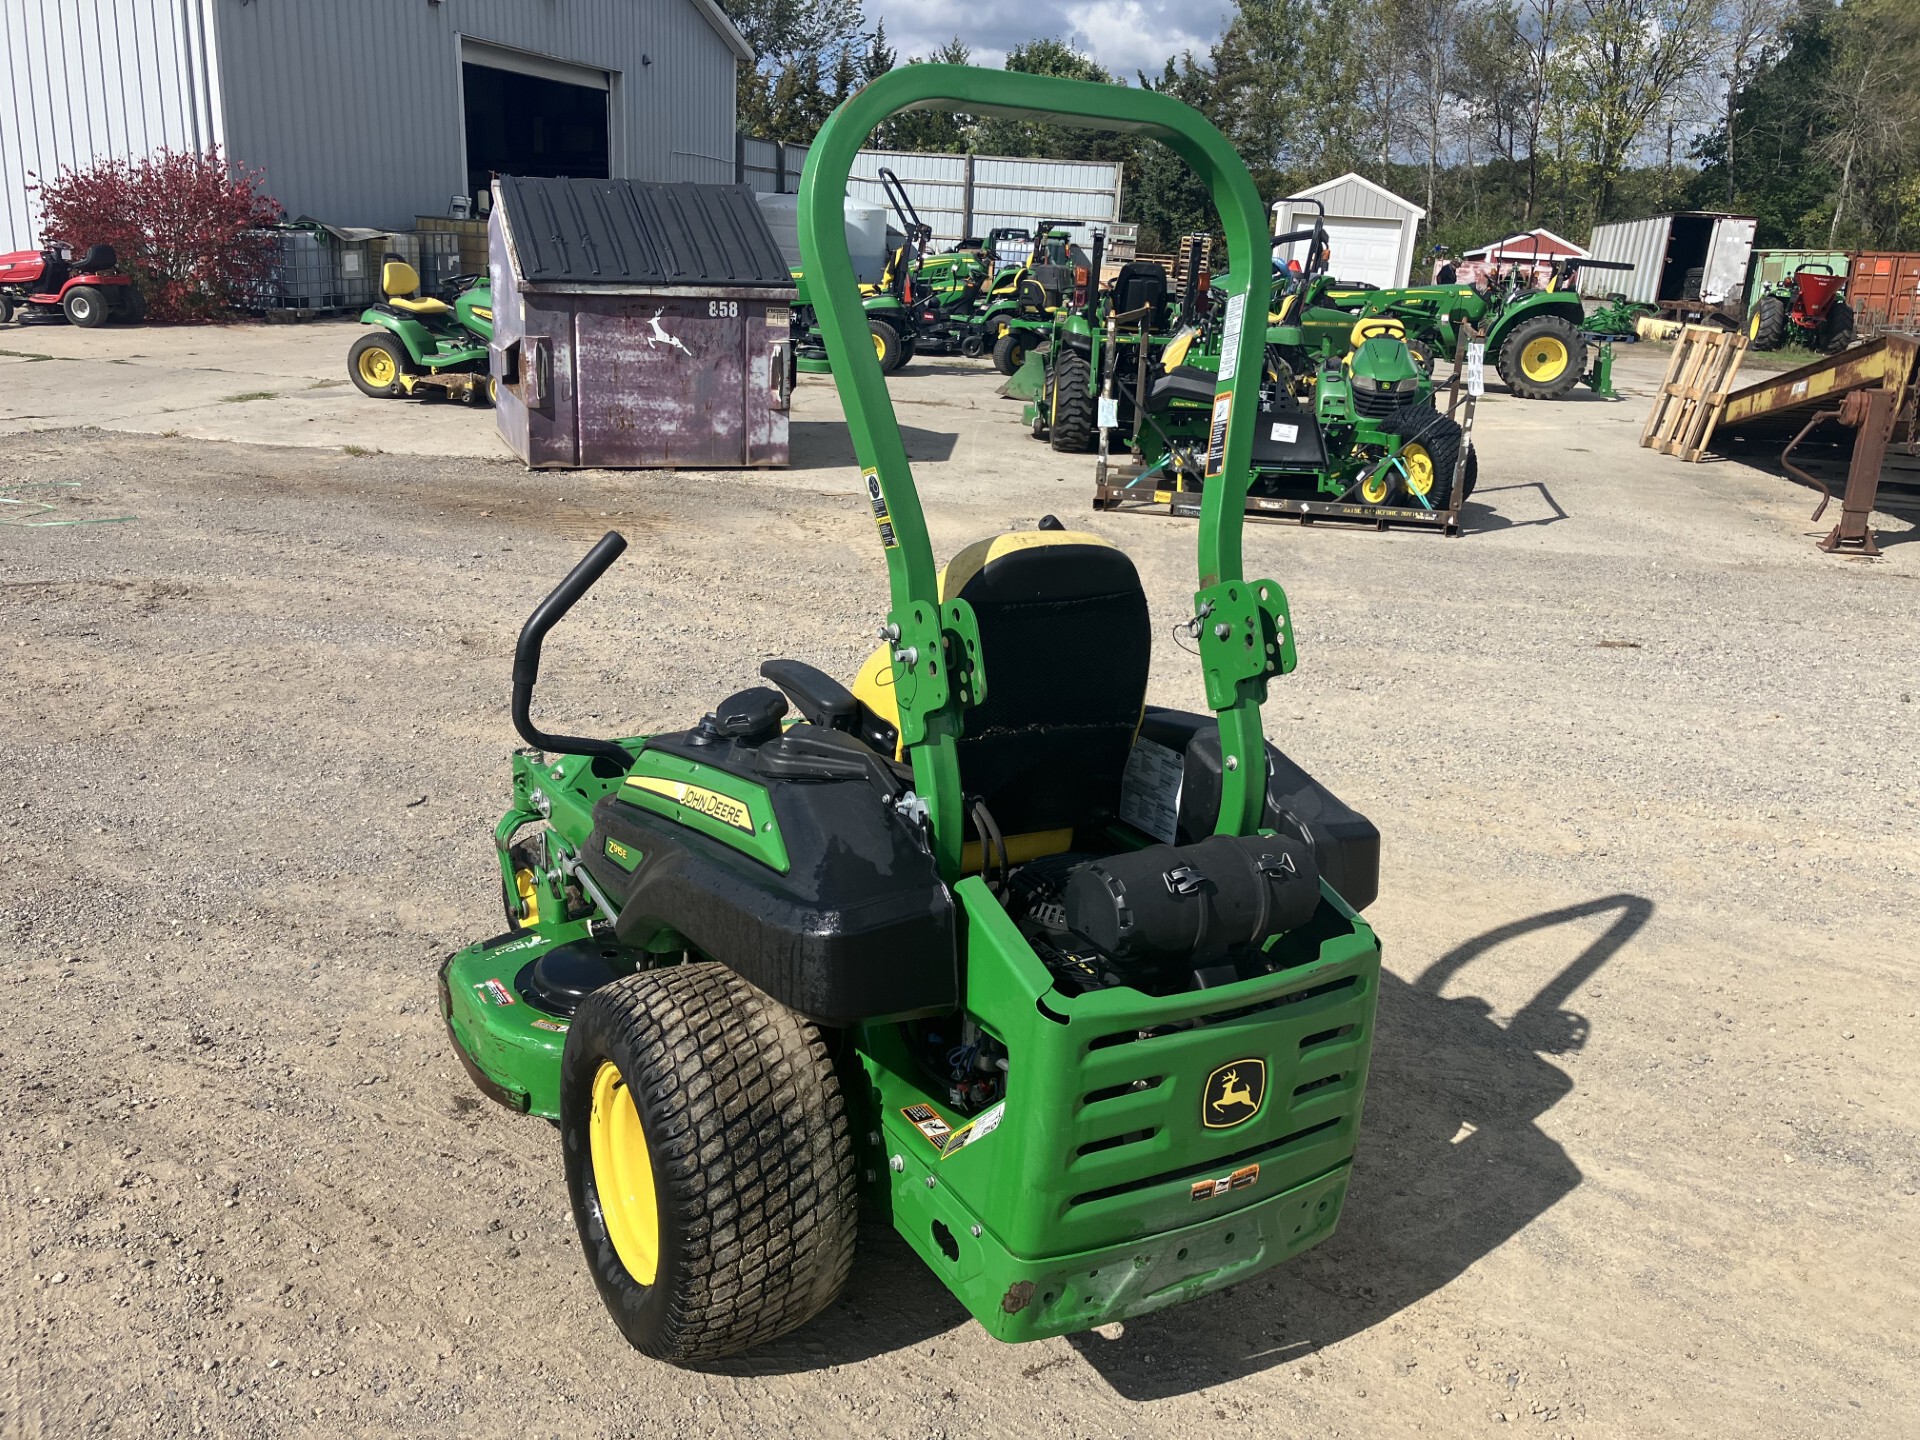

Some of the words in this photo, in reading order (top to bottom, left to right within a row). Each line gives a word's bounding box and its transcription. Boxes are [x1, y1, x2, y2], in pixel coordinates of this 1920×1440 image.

[709, 300, 738, 318] 858
[681, 787, 708, 810] JOHN
[707, 795, 743, 823] DEERE
[608, 840, 627, 860] Z915E
